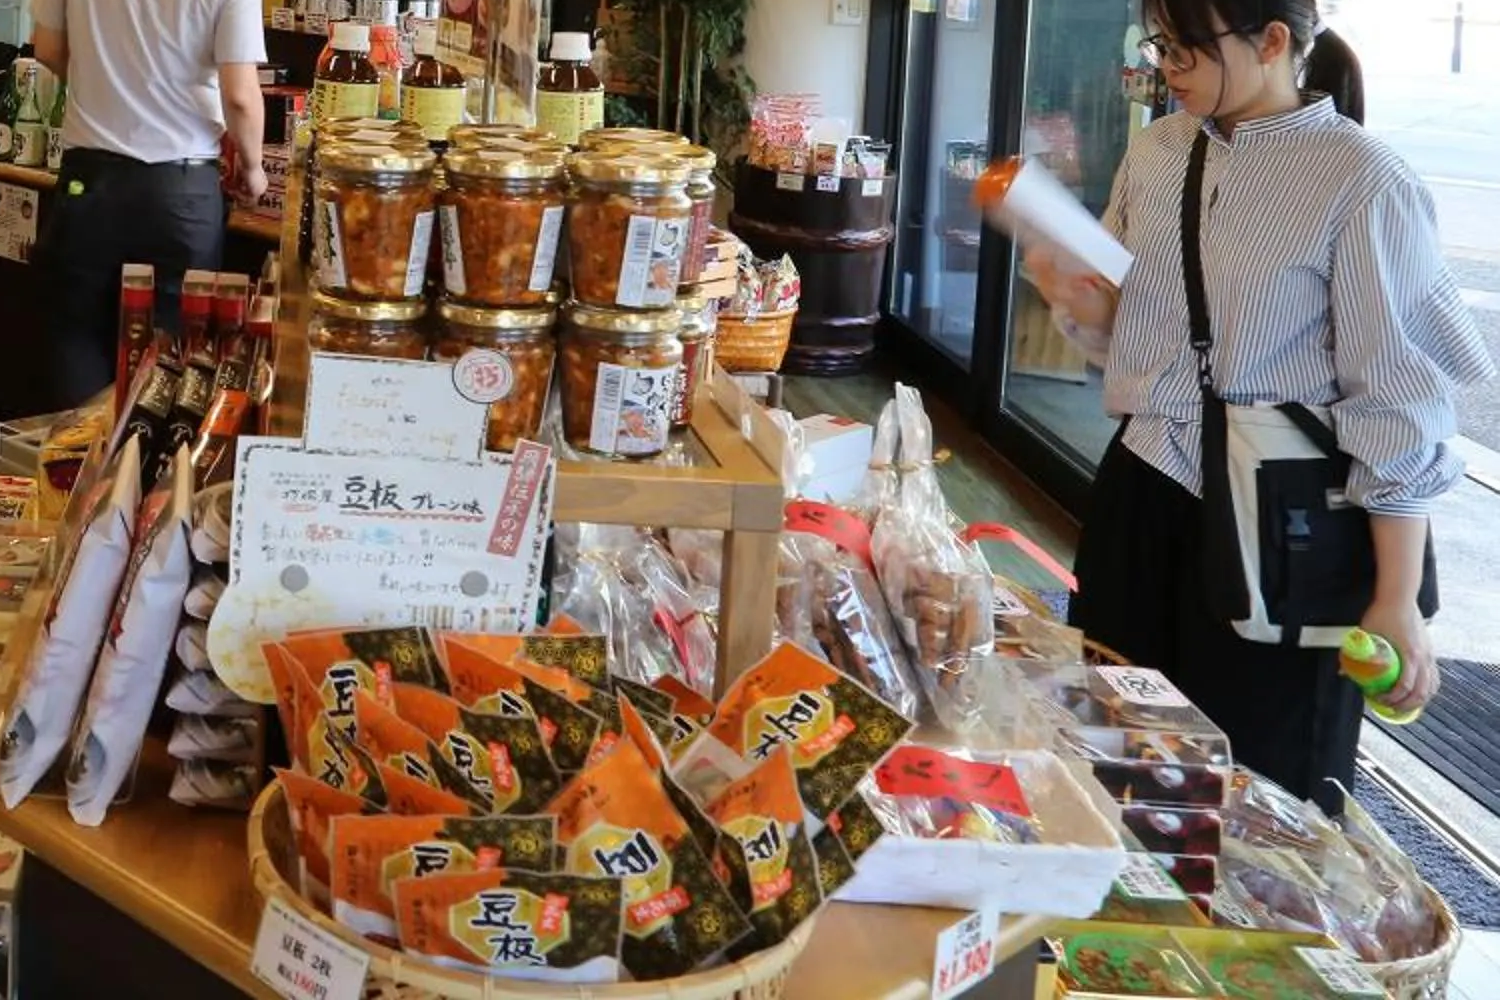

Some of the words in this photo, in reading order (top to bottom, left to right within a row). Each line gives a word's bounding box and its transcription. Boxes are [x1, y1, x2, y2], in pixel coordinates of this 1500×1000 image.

[339, 475, 405, 511] 豆板
[413, 496, 486, 515] プレーン味
[471, 893, 547, 967] 豆板
